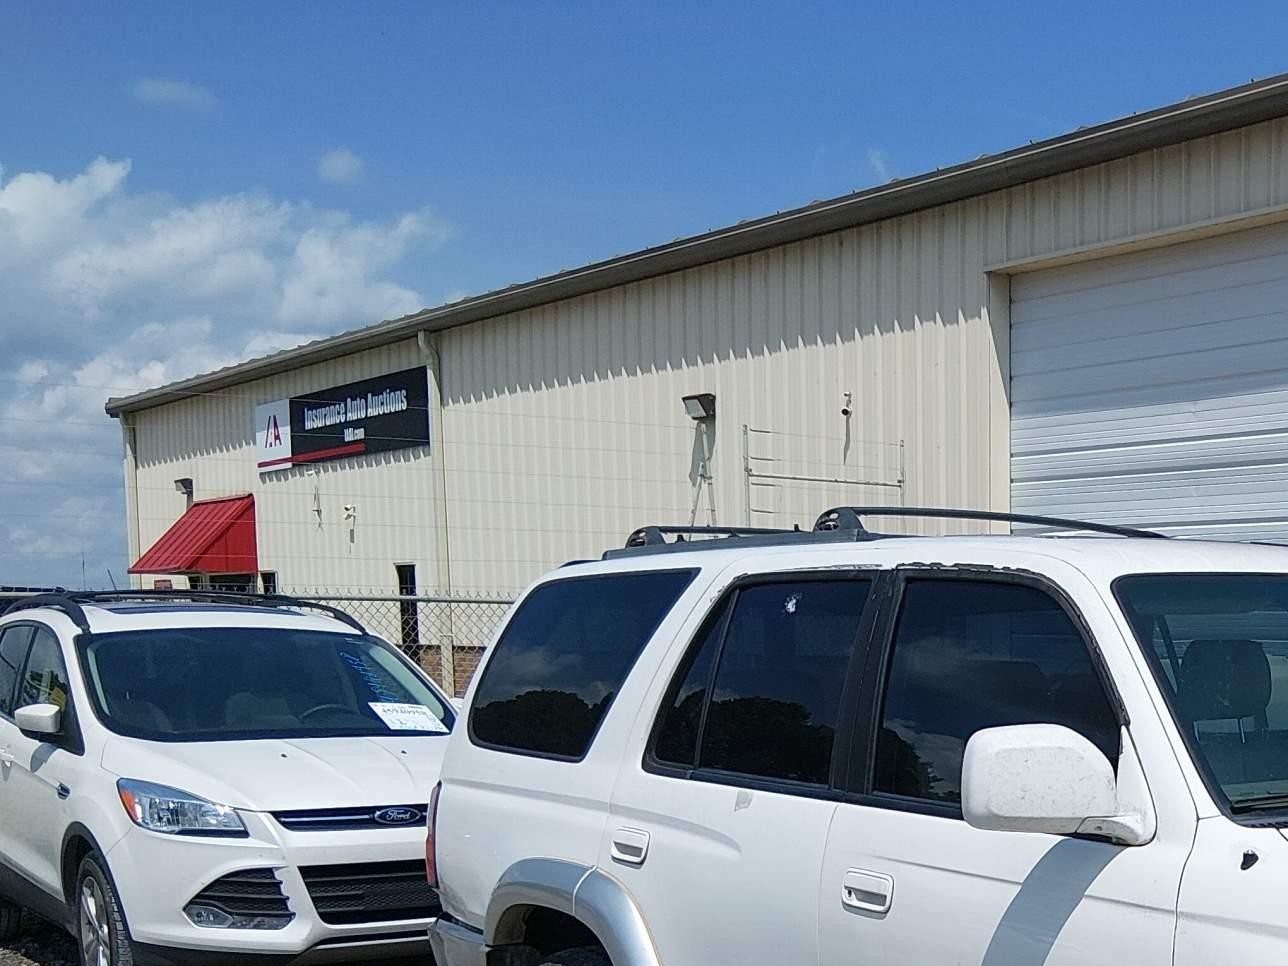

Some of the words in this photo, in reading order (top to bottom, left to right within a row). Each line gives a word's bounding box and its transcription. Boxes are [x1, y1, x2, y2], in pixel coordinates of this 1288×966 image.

[304, 404, 345, 430] Insurance
[346, 397, 366, 422] Auto
[367, 389, 407, 416] Auctions
[386, 809, 411, 821] Ford
